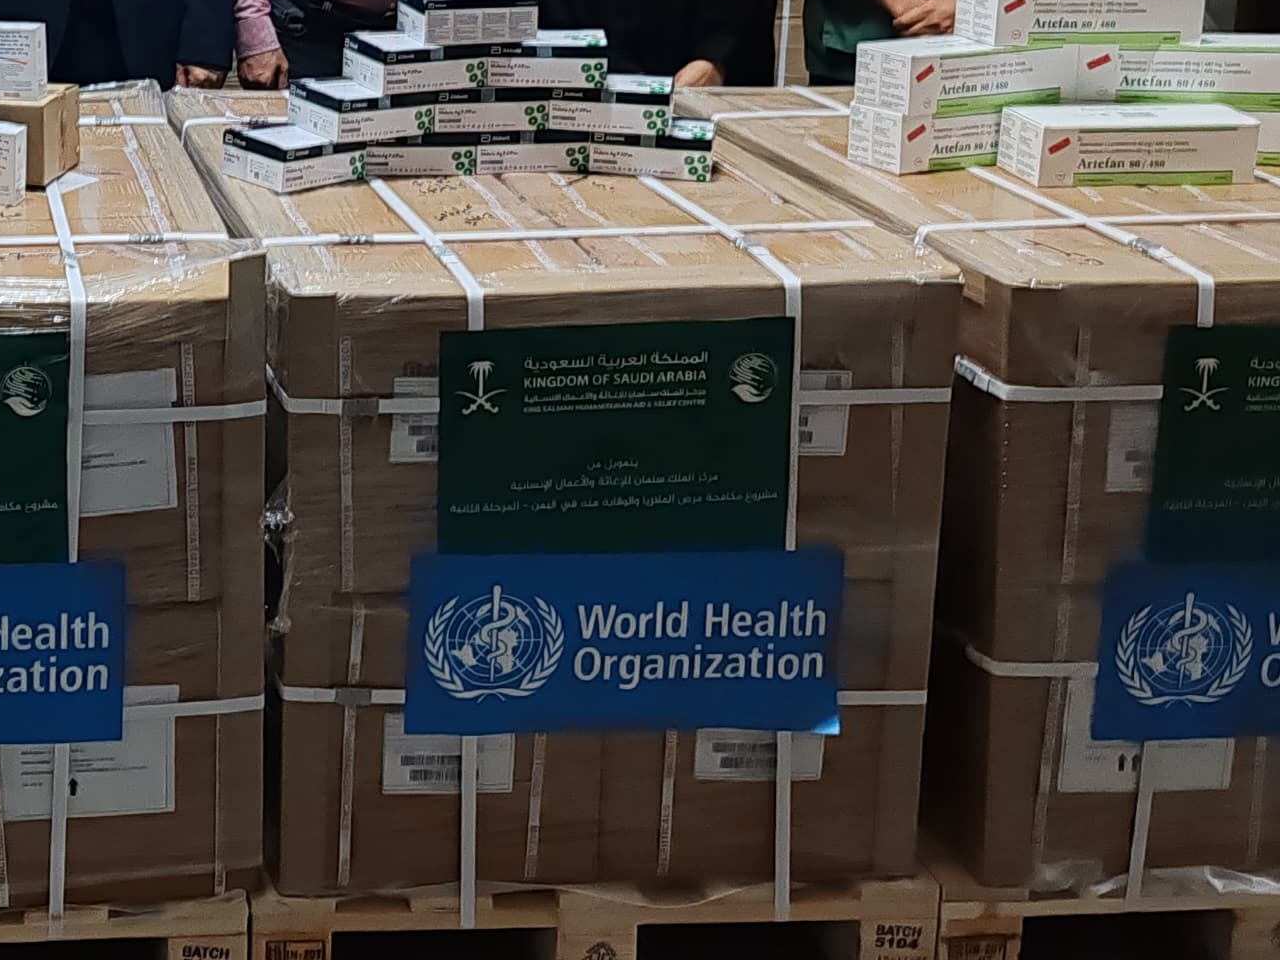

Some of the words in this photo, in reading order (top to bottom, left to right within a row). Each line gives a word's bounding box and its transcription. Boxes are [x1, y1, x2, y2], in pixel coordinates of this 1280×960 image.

[1032, 18, 1078, 29] Artefan
[1120, 75, 1172, 88] Artefan
[1176, 79, 1189, 88] 80
[1197, 78, 1216, 88] 480
[940, 83, 977, 96] Artefan
[932, 142, 971, 154] Artefan
[1078, 158, 1125, 170] Artefan
[1129, 160, 1141, 169] 80
[524, 356, 594, 373] السعودية
[598, 354, 646, 369] العربية
[650, 351, 708, 365] المملكة
[524, 376, 588, 389] KINGDOM
[592, 374, 610, 385] OF
[614, 372, 654, 385] SAUDI
[657, 370, 707, 383] ARABIA
[578, 601, 688, 639] World
[705, 600, 827, 638] Health
[574, 644, 824, 690] Organization
[876, 924, 921, 937] BATCH
[875, 937, 919, 949] 5104
[182, 946, 230, 960] BATCH
